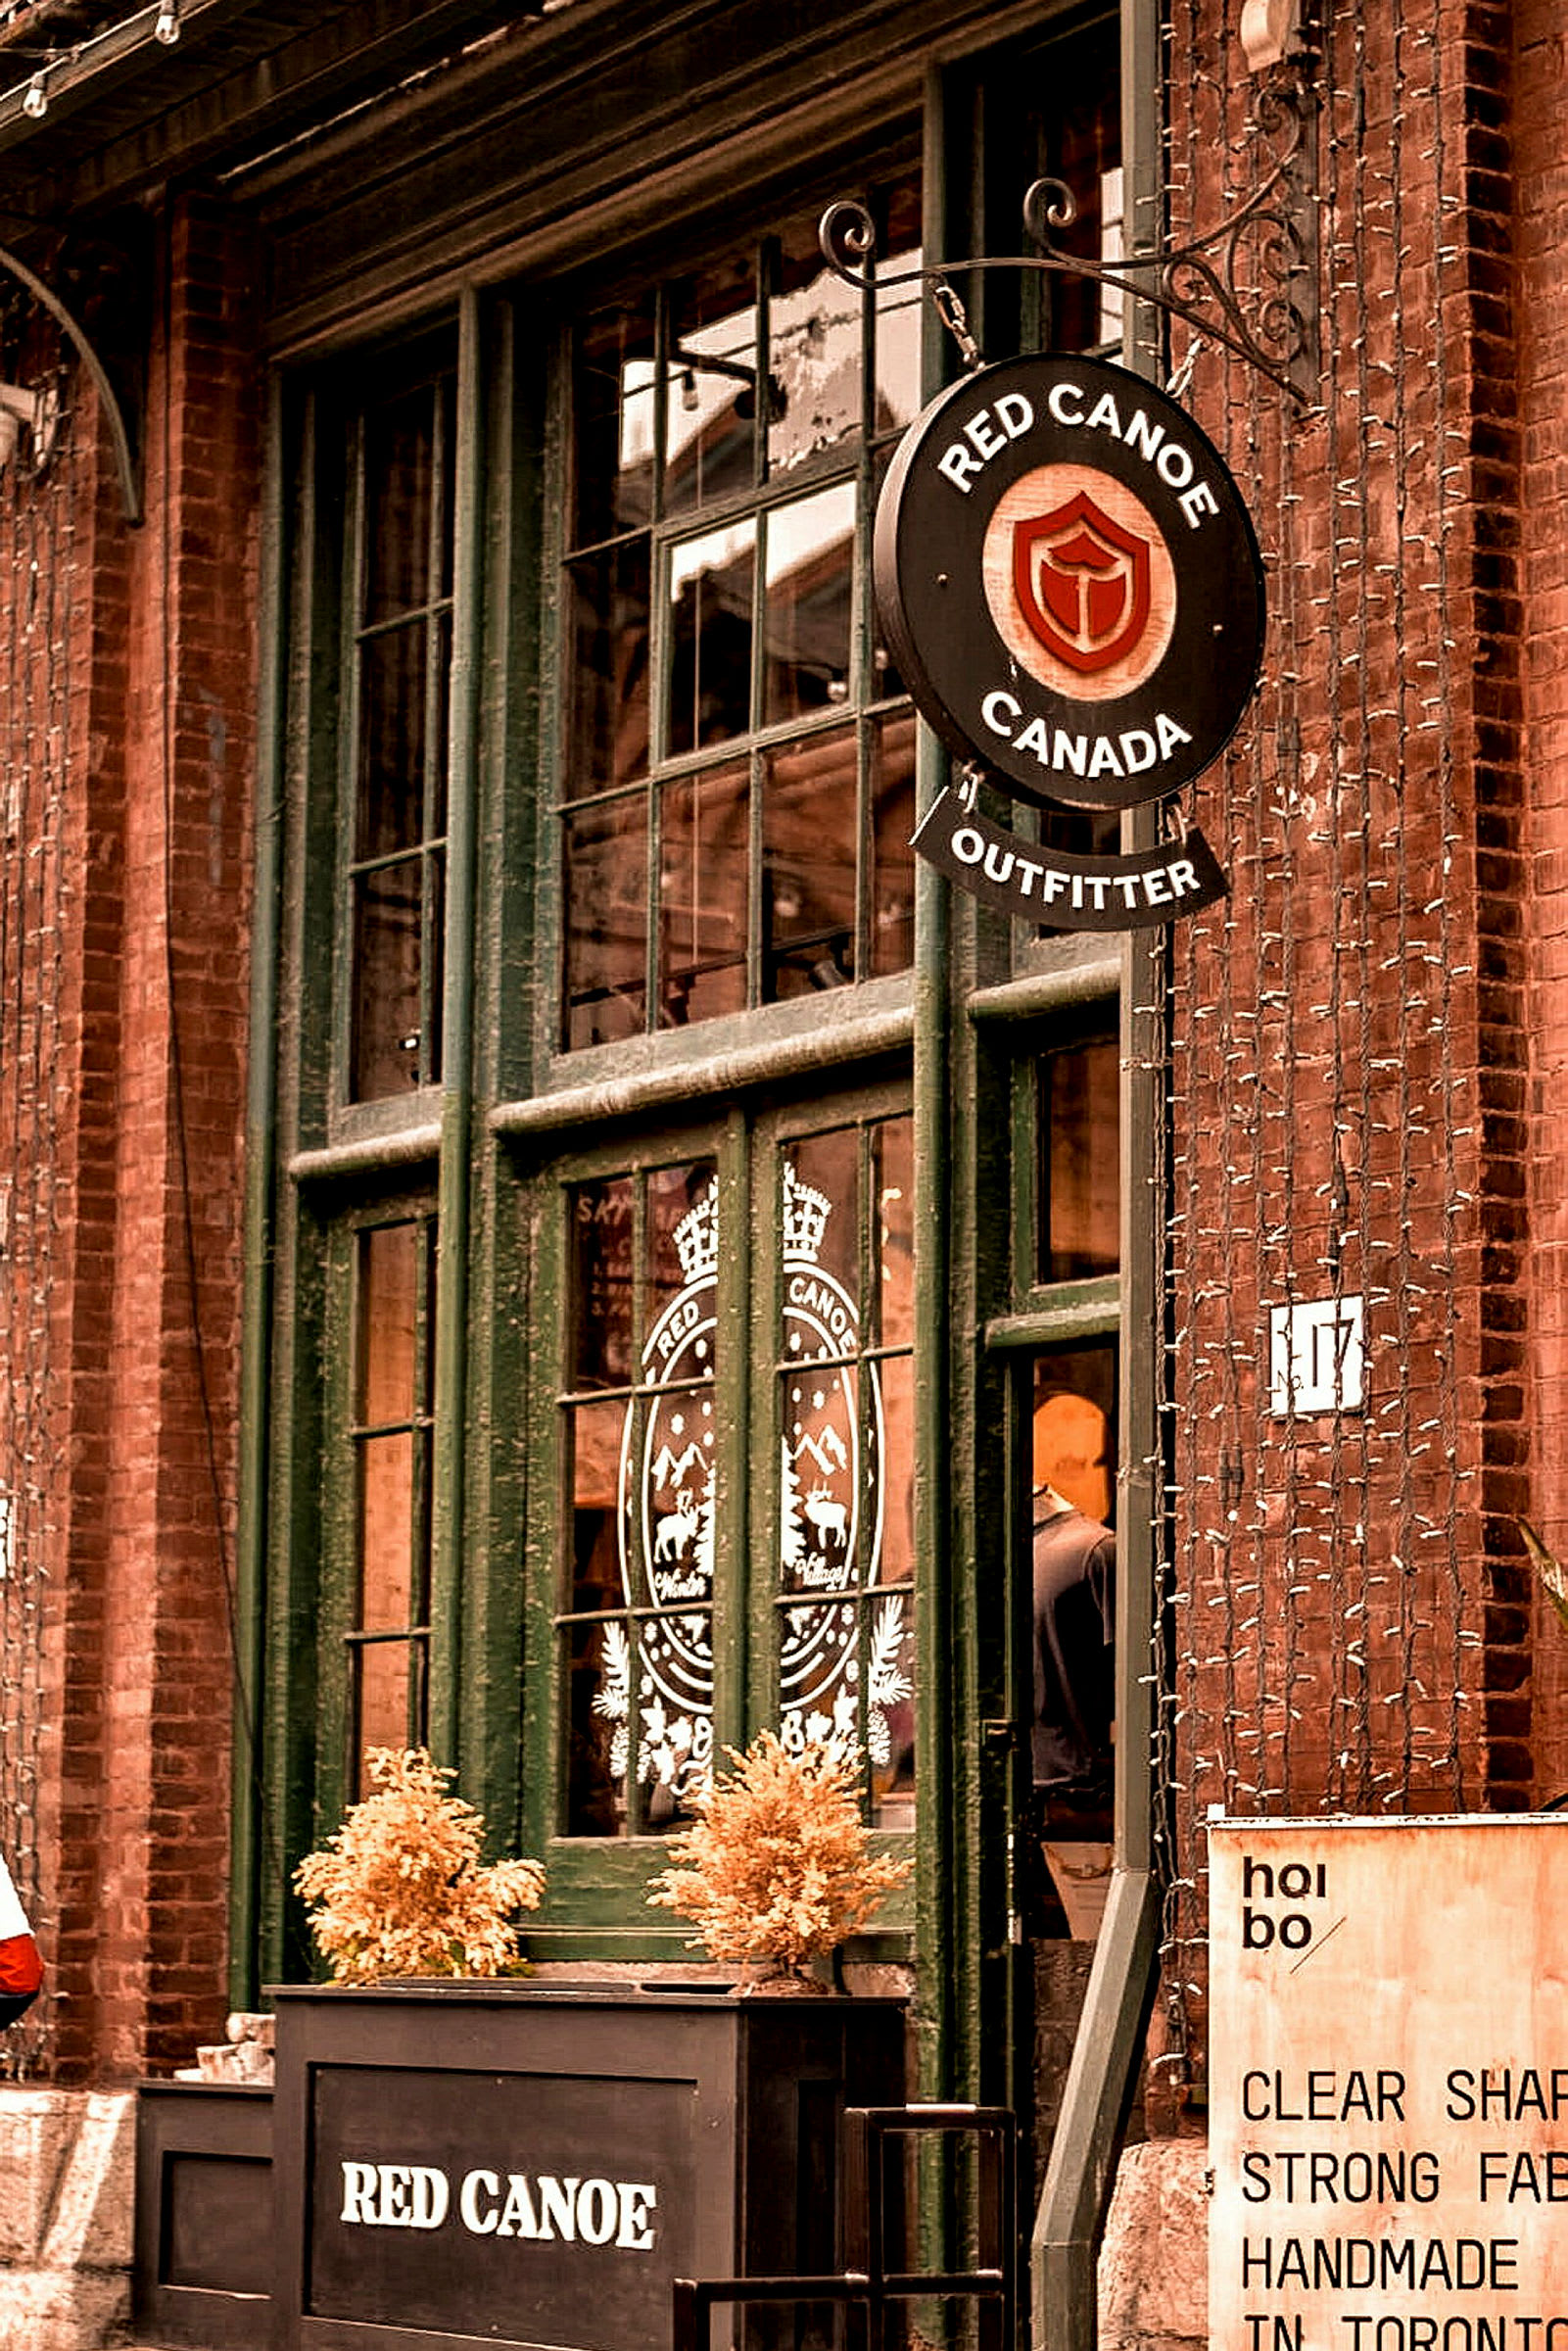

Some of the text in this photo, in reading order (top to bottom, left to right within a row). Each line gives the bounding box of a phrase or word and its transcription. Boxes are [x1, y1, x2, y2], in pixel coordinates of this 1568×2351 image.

[937, 383, 1219, 529] RED CANOE
[981, 691, 1193, 778] CANADA
[951, 828, 1201, 909] OUTFITTER
[657, 1276, 857, 1359] RED CANOE
[1242, 1906, 1312, 1949] bo
[1243, 2069, 1406, 2122] CLEAR
[340, 2161, 657, 2250] RED CANOE
[1242, 2151, 1440, 2203] STRONG
[1242, 2236, 1519, 2290] HANDMADE
[1244, 2314, 1305, 2351] IN
